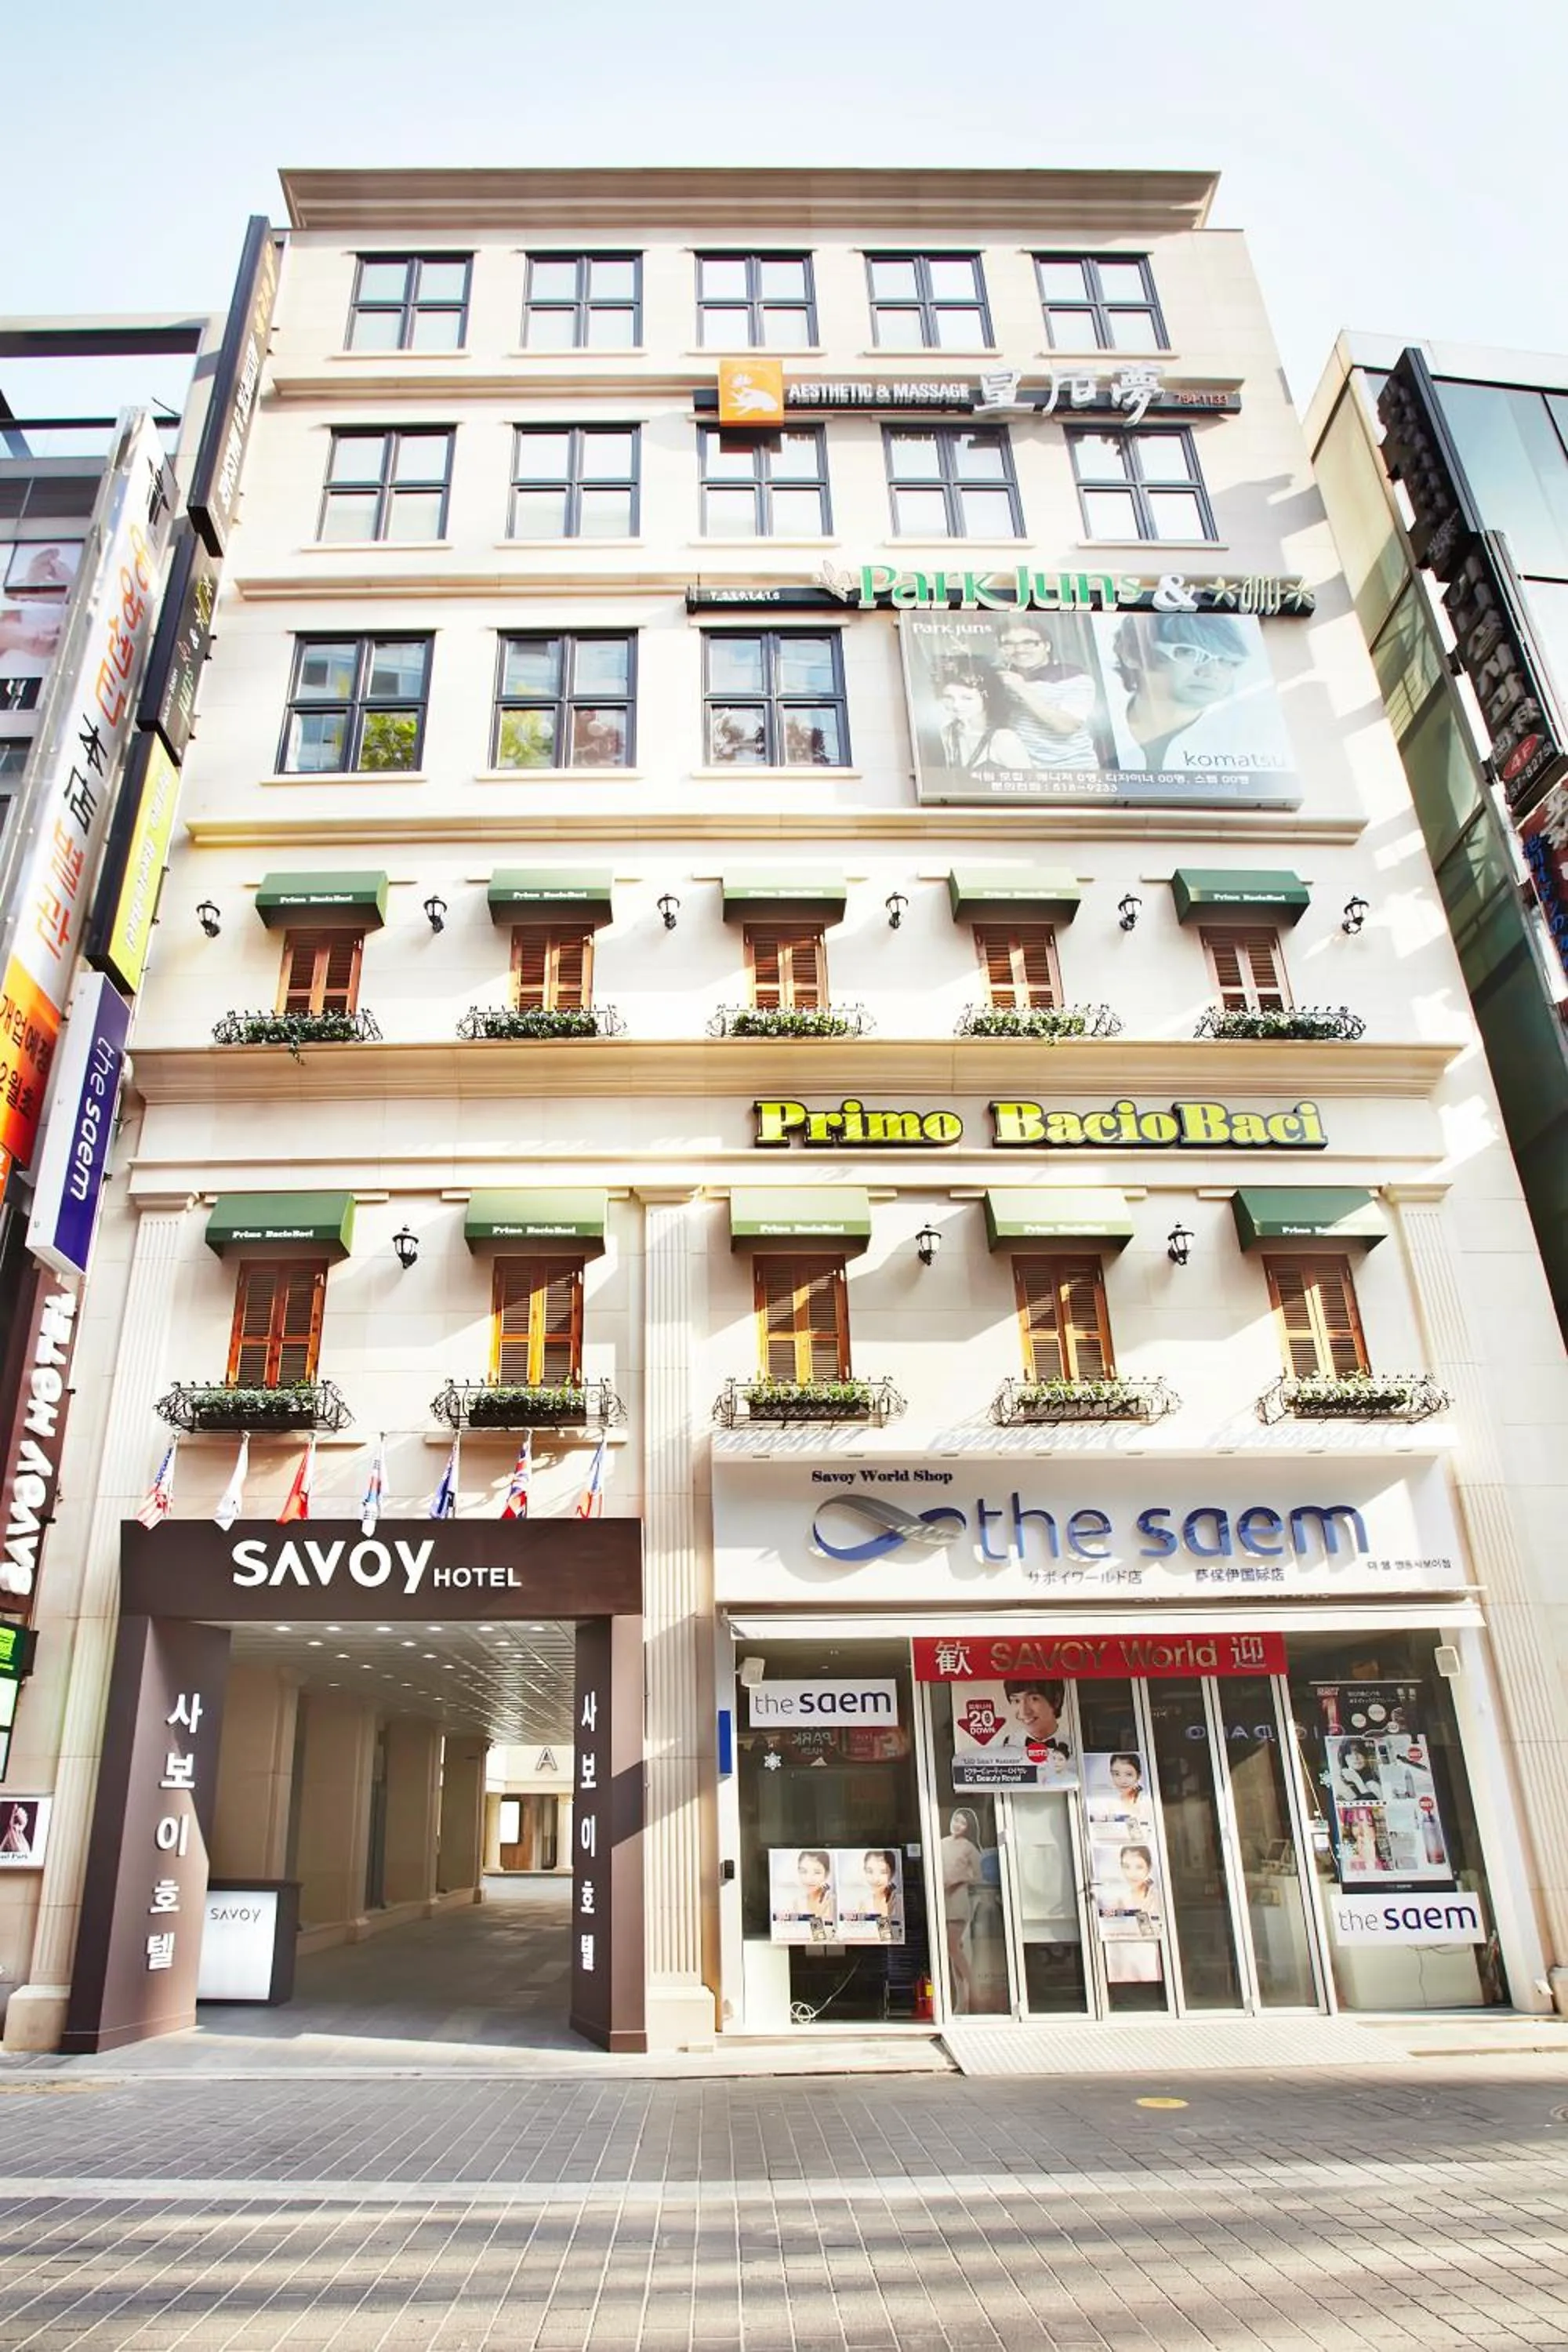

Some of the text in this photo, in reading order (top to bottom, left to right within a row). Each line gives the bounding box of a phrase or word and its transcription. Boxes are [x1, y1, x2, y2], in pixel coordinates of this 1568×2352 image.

[789, 383, 970, 401] AESTHETIC & MASSAGE
[858, 565, 1004, 610] Park
[1152, 573, 1198, 612] &
[64, 712, 108, 837] 本店
[71, 1036, 116, 1202] the saem
[754, 1099, 1330, 1150] Primo BacioBaci
[811, 1469, 953, 1485] Savoy World Shop
[0, 1439, 54, 1596] SAVOY
[976, 1493, 1370, 1560] the saem
[231, 1539, 522, 1593] SAVOY HOTEL
[990, 1639, 1218, 1673] SAVOY World
[1230, 1635, 1269, 1670] 迎
[754, 1691, 892, 1715] the saem
[968, 1710, 995, 1728] 20
[535, 1745, 558, 1772] A
[146, 1692, 204, 1971] 사보이호텔
[579, 1691, 597, 1971] 사보이호텔
[210, 1907, 262, 1923] SAVOY
[1338, 1906, 1478, 1932] the saem
